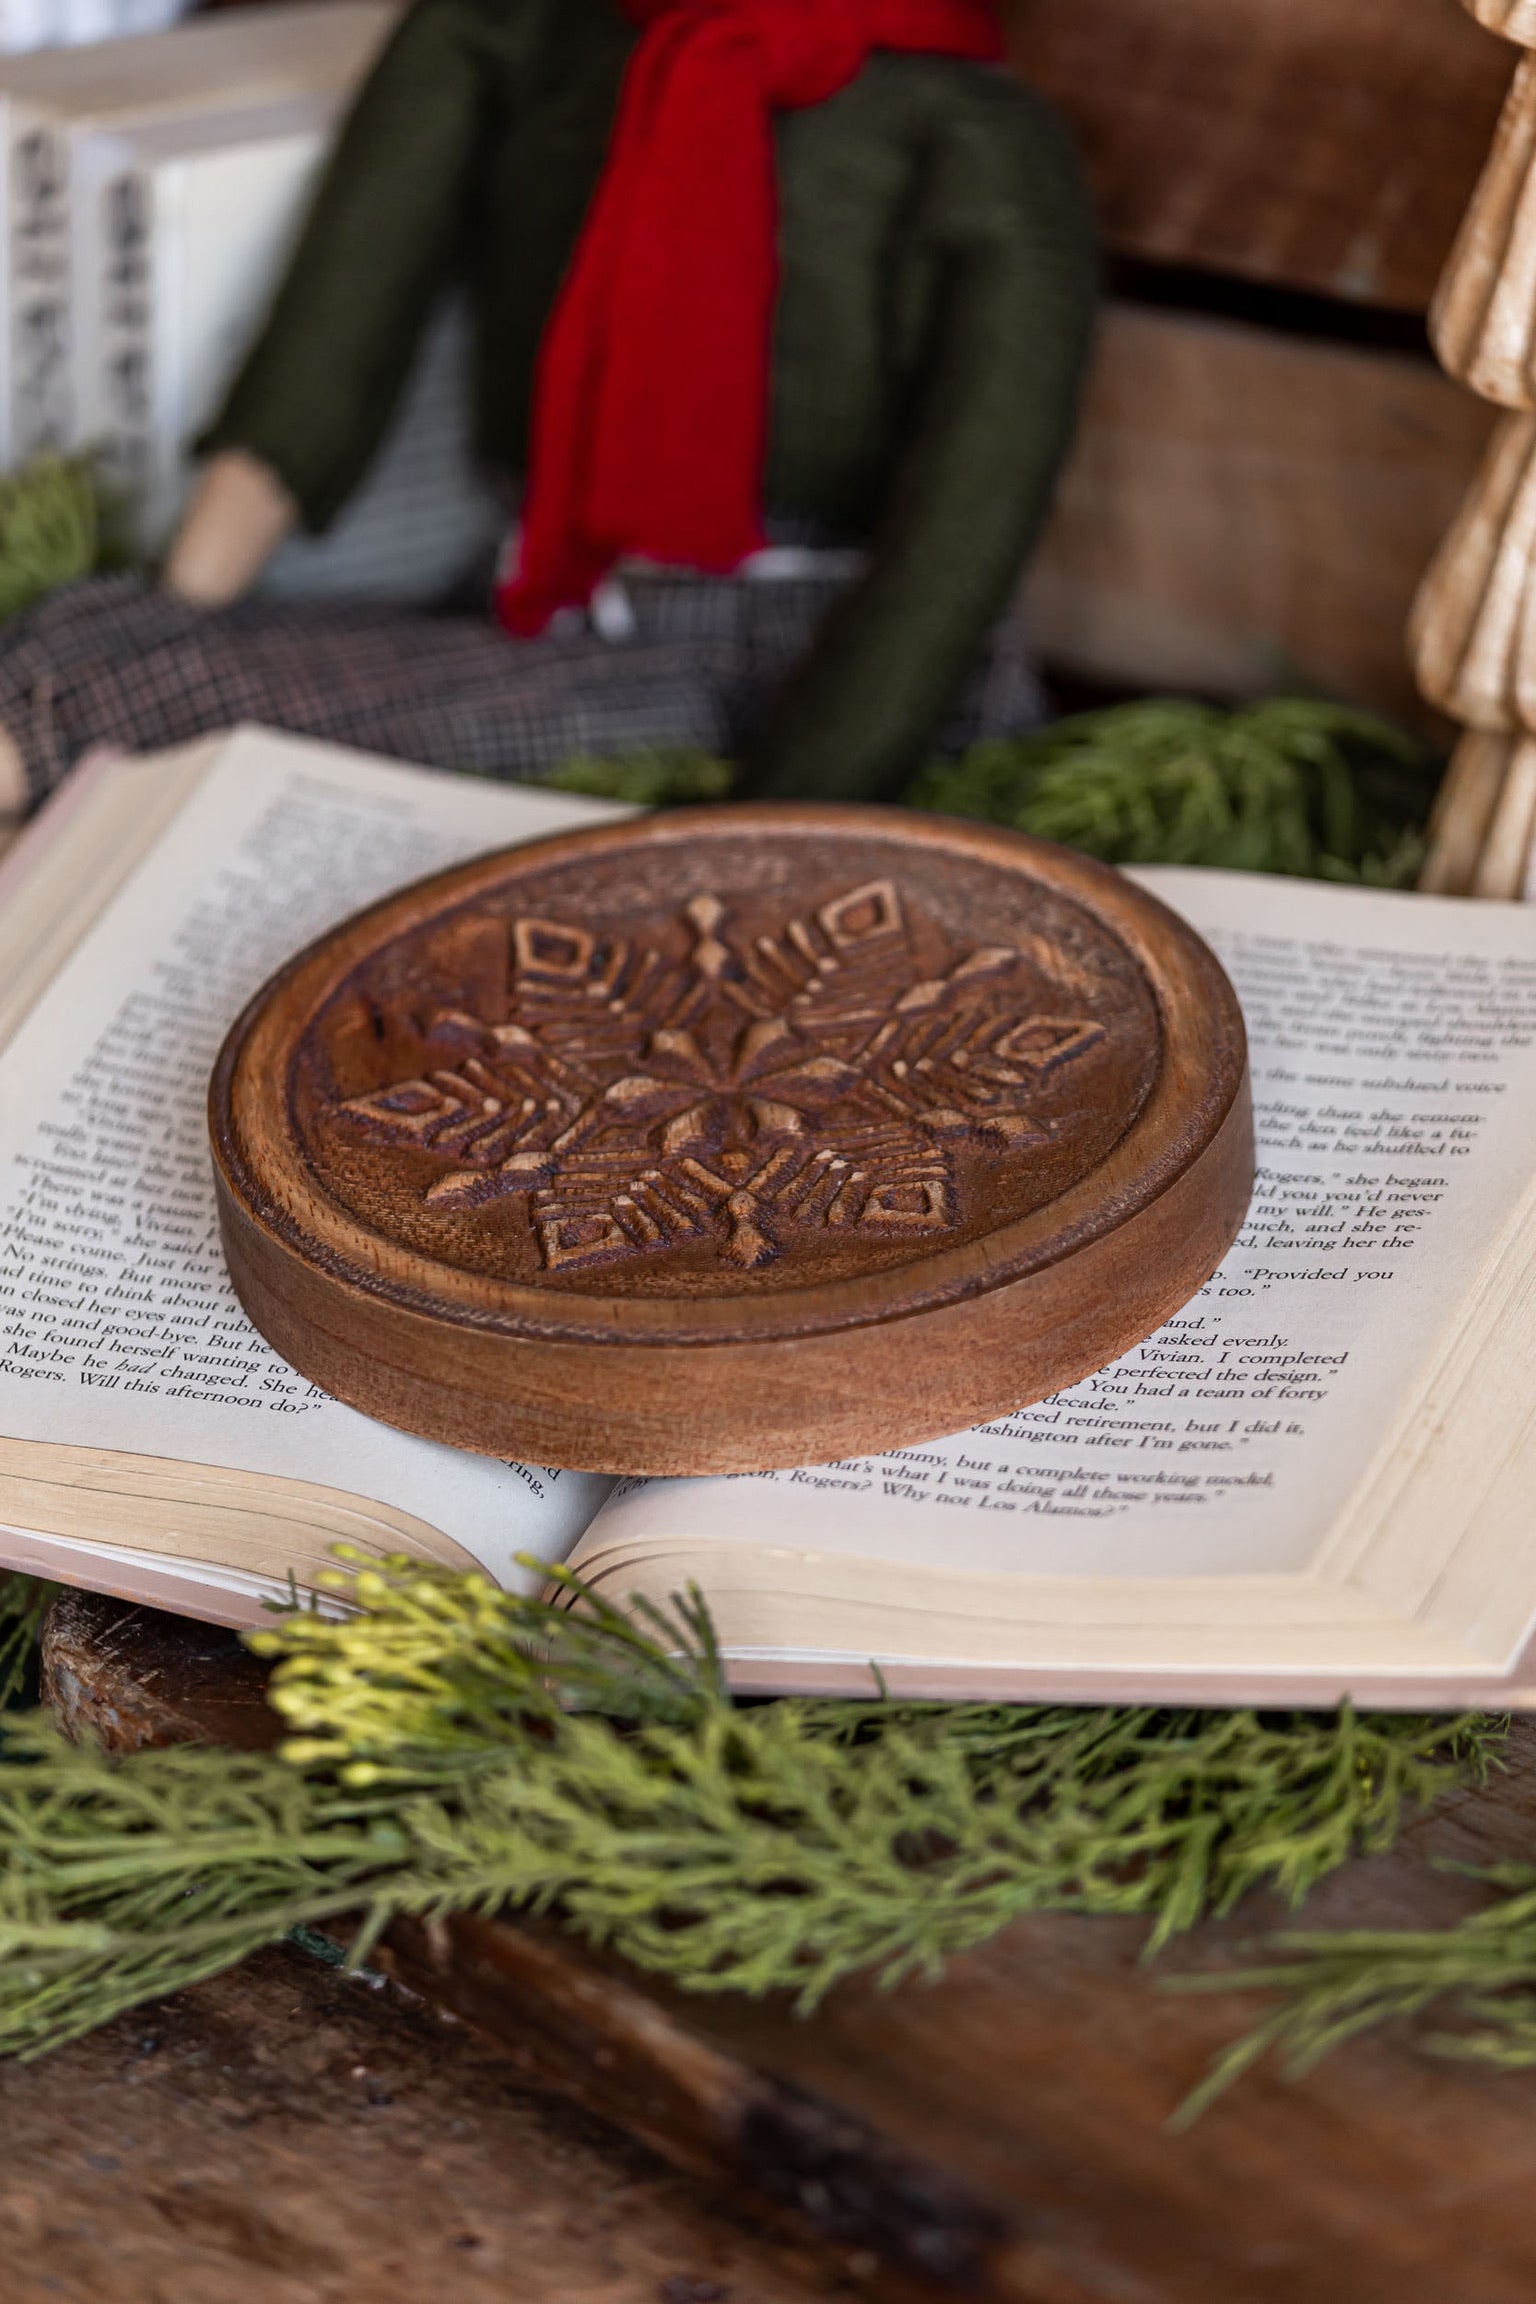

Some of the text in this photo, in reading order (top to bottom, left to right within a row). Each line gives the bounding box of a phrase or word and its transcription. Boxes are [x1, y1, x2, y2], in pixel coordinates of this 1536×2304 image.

[1455, 1081, 1507, 1093] voice
[1369, 1107, 1404, 1122] she
[1387, 1125, 1425, 1139] like
[1363, 1140, 1446, 1155] shuffled
[1449, 1144, 1472, 1156] to
[1345, 1173, 1379, 1187] she
[1386, 1174, 1450, 1189] began.
[1282, 1189, 1317, 1203] you
[1386, 1192, 1444, 1203] never
[1256, 1204, 1289, 1218] my
[1354, 1205, 1388, 1219] He
[1391, 1207, 1433, 1220] ges-
[1305, 1220, 1347, 1233] and
[1351, 1222, 1387, 1233] she
[1394, 1224, 1423, 1233] re-
[1266, 1236, 1338, 1252] leaving
[1341, 1236, 1378, 1249] her
[1381, 1236, 1415, 1249] the
[3, 1243, 35, 1262] No
[40, 1256, 108, 1278] strings.
[119, 1267, 154, 1285] But
[160, 1275, 213, 1292] more
[131, 1252, 177, 1270] Just
[182, 1258, 213, 1275] for
[1244, 1268, 1395, 1282] “Provided you
[28, 1270, 73, 1289] time
[78, 1281, 99, 1294] to
[104, 1284, 157, 1303] think
[162, 1293, 220, 1311] about
[225, 1304, 237, 1314] a
[21, 1288, 86, 1310] closed
[88, 1299, 122, 1316] her
[125, 1308, 167, 1322] eyes
[170, 1314, 212, 1328] and
[31, 1311, 58, 1324] no
[61, 1318, 102, 1331] and
[101, 1323, 199, 1345] good-bye.
[207, 1333, 244, 1351] But
[3, 1322, 289, 1376] she found herself wanting to
[1157, 1334, 1218, 1347] asked
[1222, 1334, 1289, 1349] evenly.
[1139, 1348, 1350, 1367] Vivian. I completed
[6, 1341, 339, 1402] Maybe he had changed. She hea
[1113, 1366, 1213, 1381] perfected
[1216, 1370, 1250, 1382] the
[0, 1358, 323, 1415] Rogers. Will this afternoon do?”
[1088, 1378, 1329, 1401] You had a team of forty
[1065, 1414, 1177, 1434] retirement,
[1184, 1418, 1220, 1433] but
[1227, 1419, 1240, 1433] I
[1244, 1419, 1282, 1434] did
[1084, 1432, 1133, 1449] after
[1136, 1435, 1173, 1450] I'm
[956, 1454, 992, 1472] but
[997, 1463, 1009, 1474] a
[1015, 1466, 1111, 1482] complete
[1117, 1470, 1200, 1487] working
[789, 1469, 873, 1492] Rogers?
[882, 1480, 931, 1502] Why
[935, 1492, 971, 1507] not
[977, 1495, 1017, 1512] Los
[882, 1464, 930, 1482] what
[936, 1470, 948, 1484] I
[953, 1475, 991, 1490] was
[996, 1479, 1057, 1498] doing
[1061, 1484, 1088, 1499] all
[1092, 1485, 1148, 1501] those
